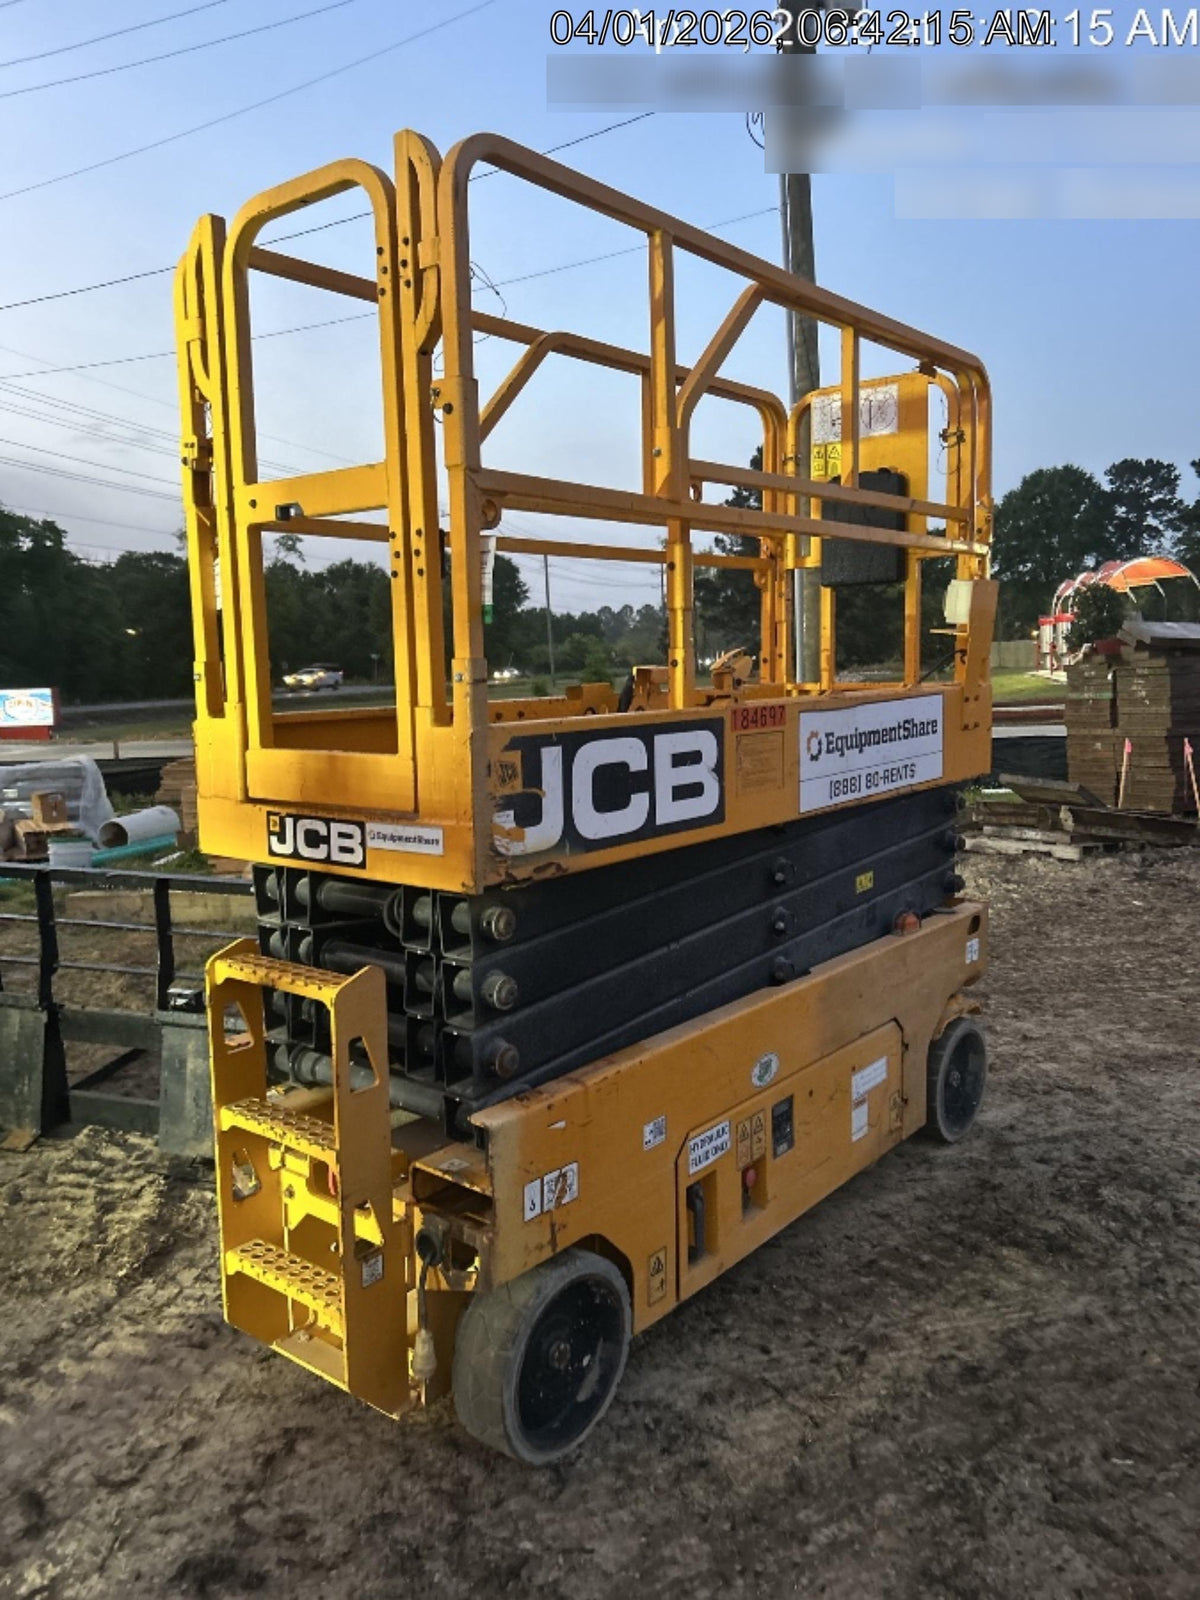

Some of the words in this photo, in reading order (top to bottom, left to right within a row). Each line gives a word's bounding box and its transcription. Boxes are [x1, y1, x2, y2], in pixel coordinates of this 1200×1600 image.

[732, 705, 786, 731] 184697
[824, 717, 938, 758] EquipmentShare
[491, 729, 720, 857] JCB
[829, 774, 862, 800] (888)
[865, 763, 917, 790] 80-RENTS
[269, 816, 364, 865] JCB
